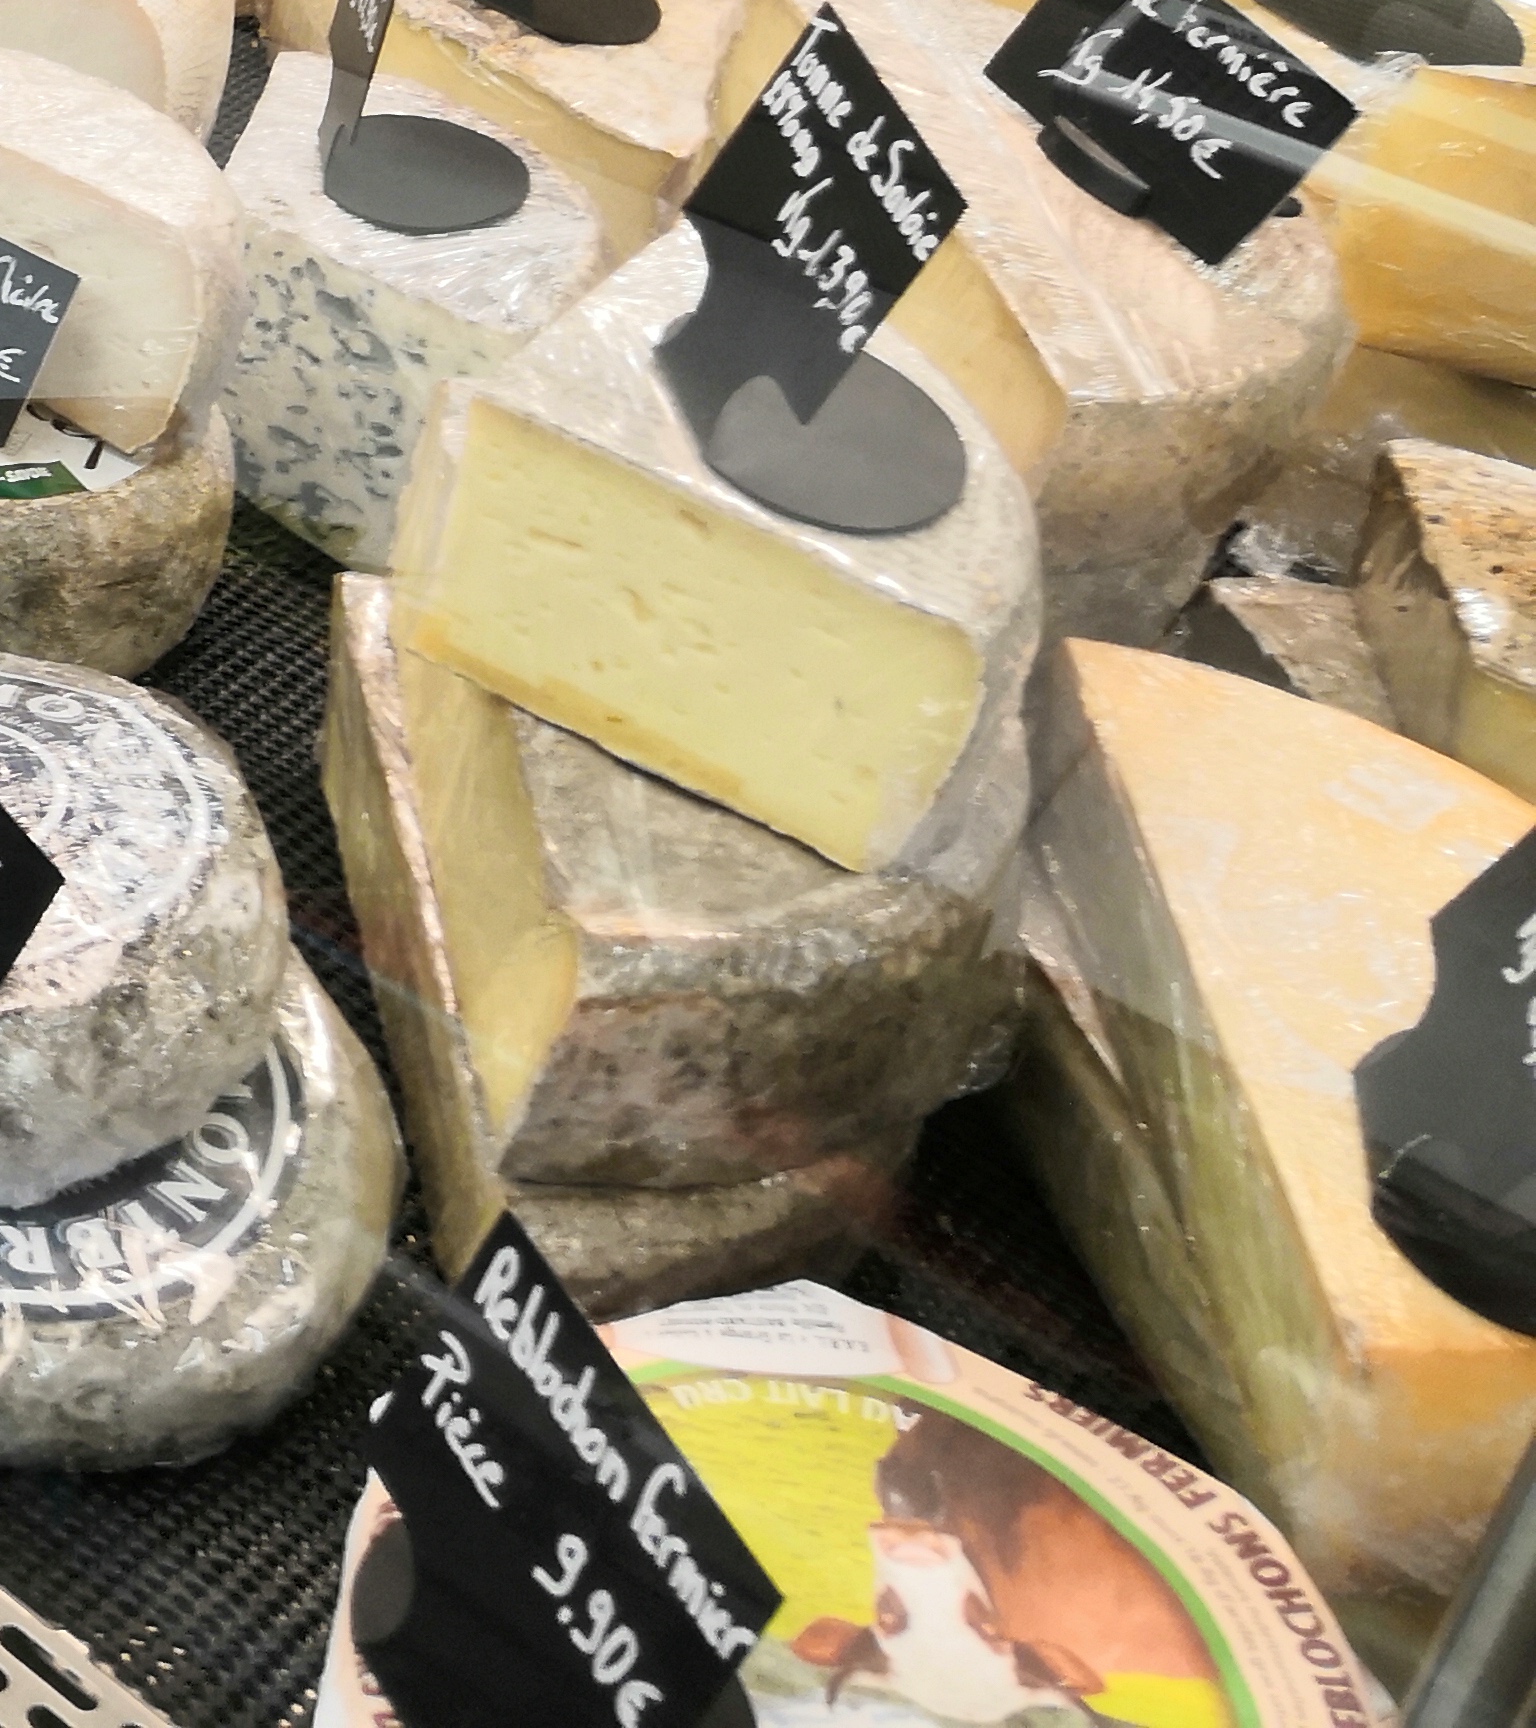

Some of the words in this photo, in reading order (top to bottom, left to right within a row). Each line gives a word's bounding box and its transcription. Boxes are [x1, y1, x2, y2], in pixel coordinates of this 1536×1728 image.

[1036, 27, 1124, 87] Kg
[790, 16, 854, 130] Tomme
[846, 115, 887, 172] de
[770, 176, 836, 258] Kg
[668, 1376, 756, 1413] CRU
[764, 1377, 855, 1415] LAIT
[858, 1393, 923, 1434] AU
[1023, 1379, 1220, 1510] FERMIERS
